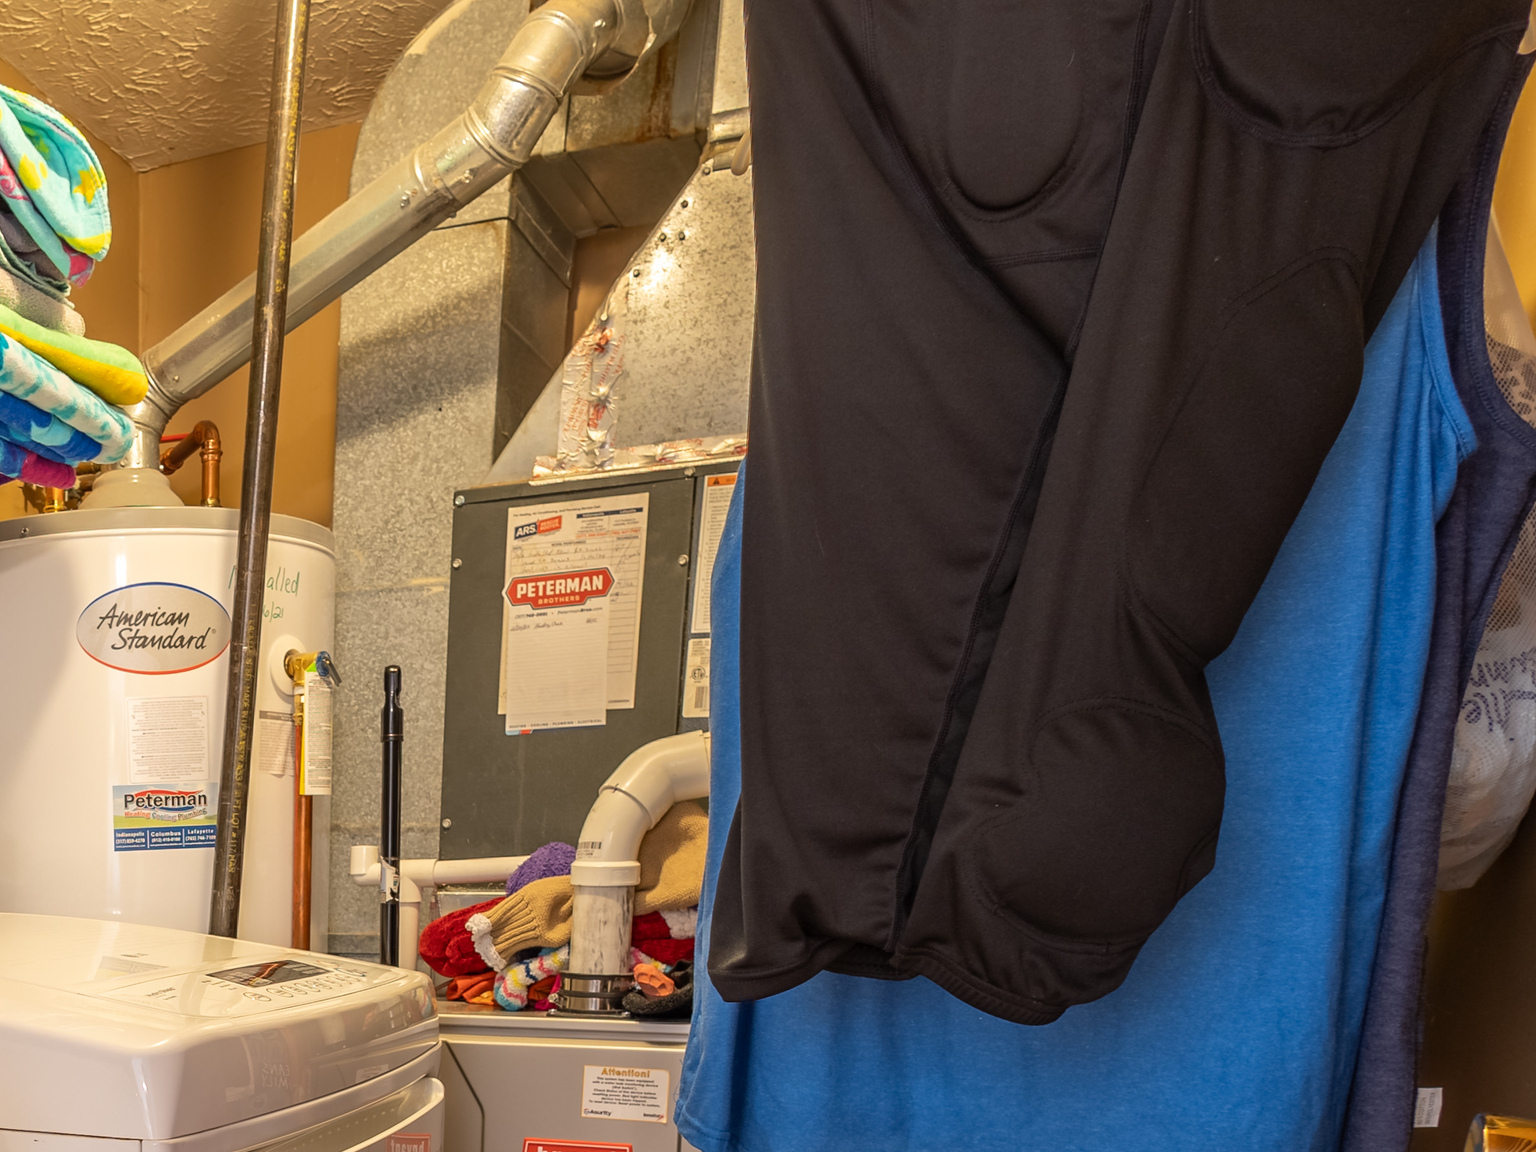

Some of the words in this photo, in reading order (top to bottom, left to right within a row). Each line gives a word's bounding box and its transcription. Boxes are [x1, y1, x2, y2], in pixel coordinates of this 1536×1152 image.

[516, 524, 536, 537] ARS
[516, 574, 603, 598] PETERMAN
[538, 595, 580, 604] BROTHERS
[97, 603, 190, 630] American
[111, 627, 211, 650] Standard
[125, 794, 207, 808] Peterman
[601, 1068, 650, 1078] Attention!
